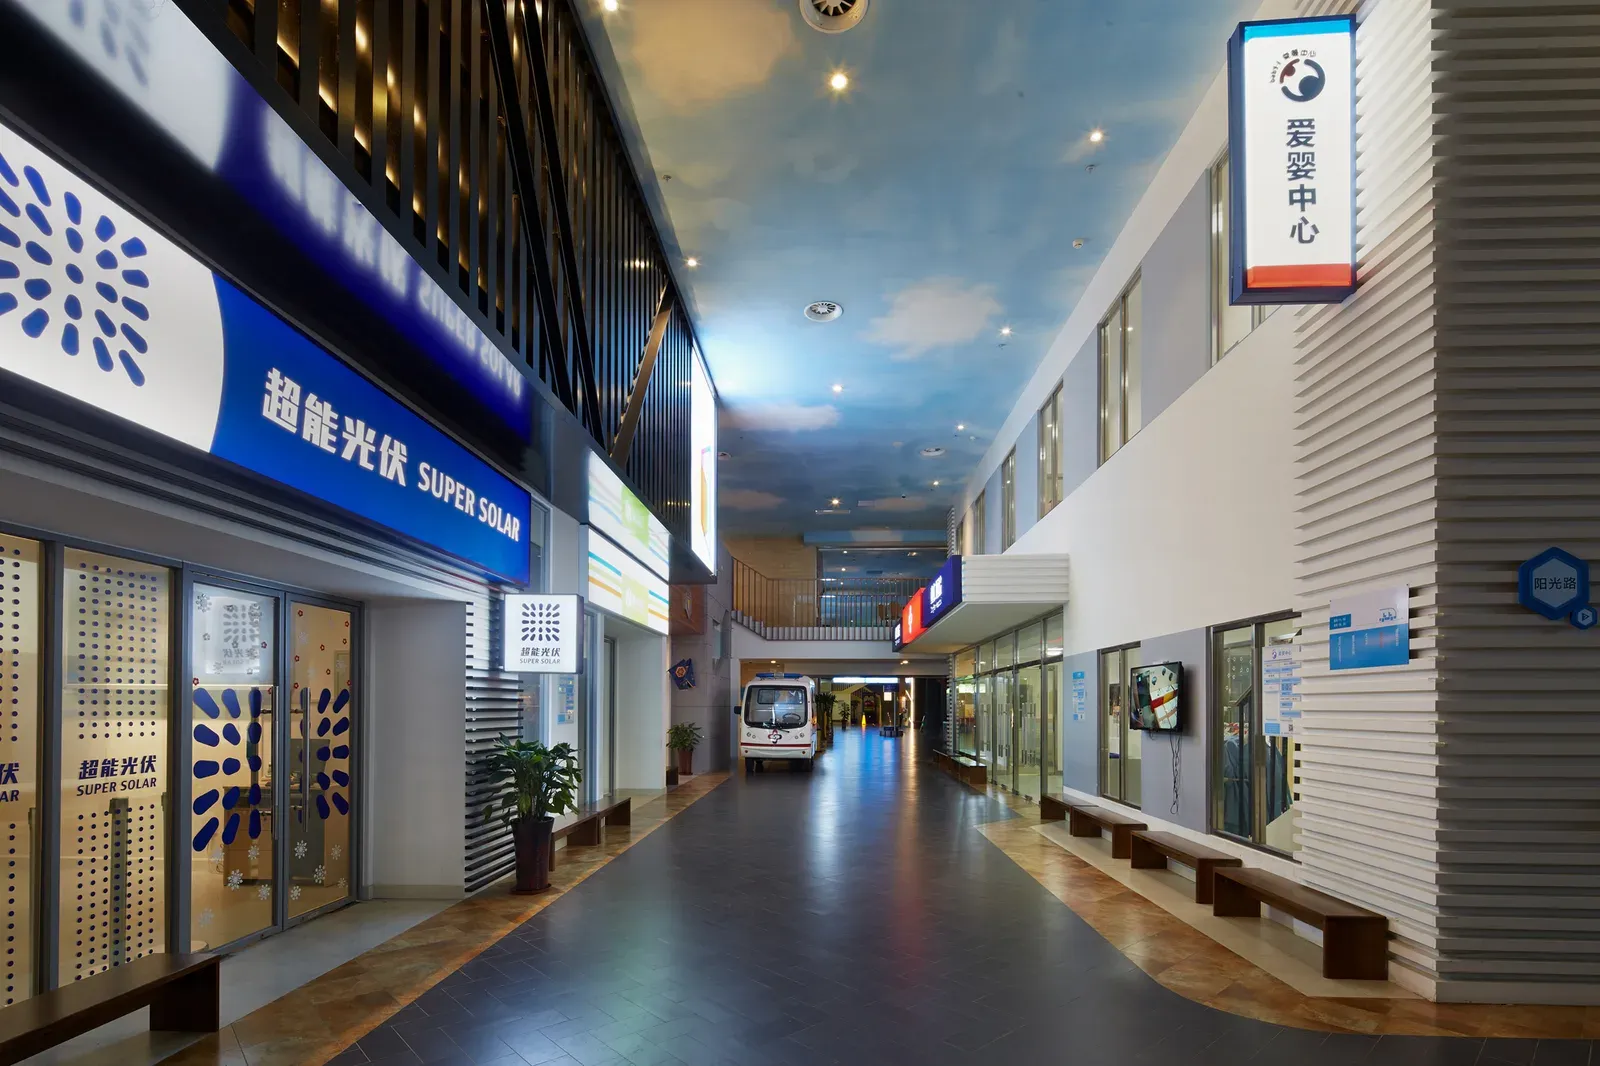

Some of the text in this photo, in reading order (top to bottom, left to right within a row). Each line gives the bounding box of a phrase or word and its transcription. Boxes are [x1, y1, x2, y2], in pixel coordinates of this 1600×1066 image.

[1286, 118, 1320, 244] 爱婴中心
[262, 367, 520, 542] 超能光伏 SUPER SOLAR
[1534, 577, 1577, 590] 阳光路
[520, 647, 560, 657] 超能光伏
[78, 755, 157, 780] 超能光伏
[76, 777, 157, 796] SUPER SOLAR
